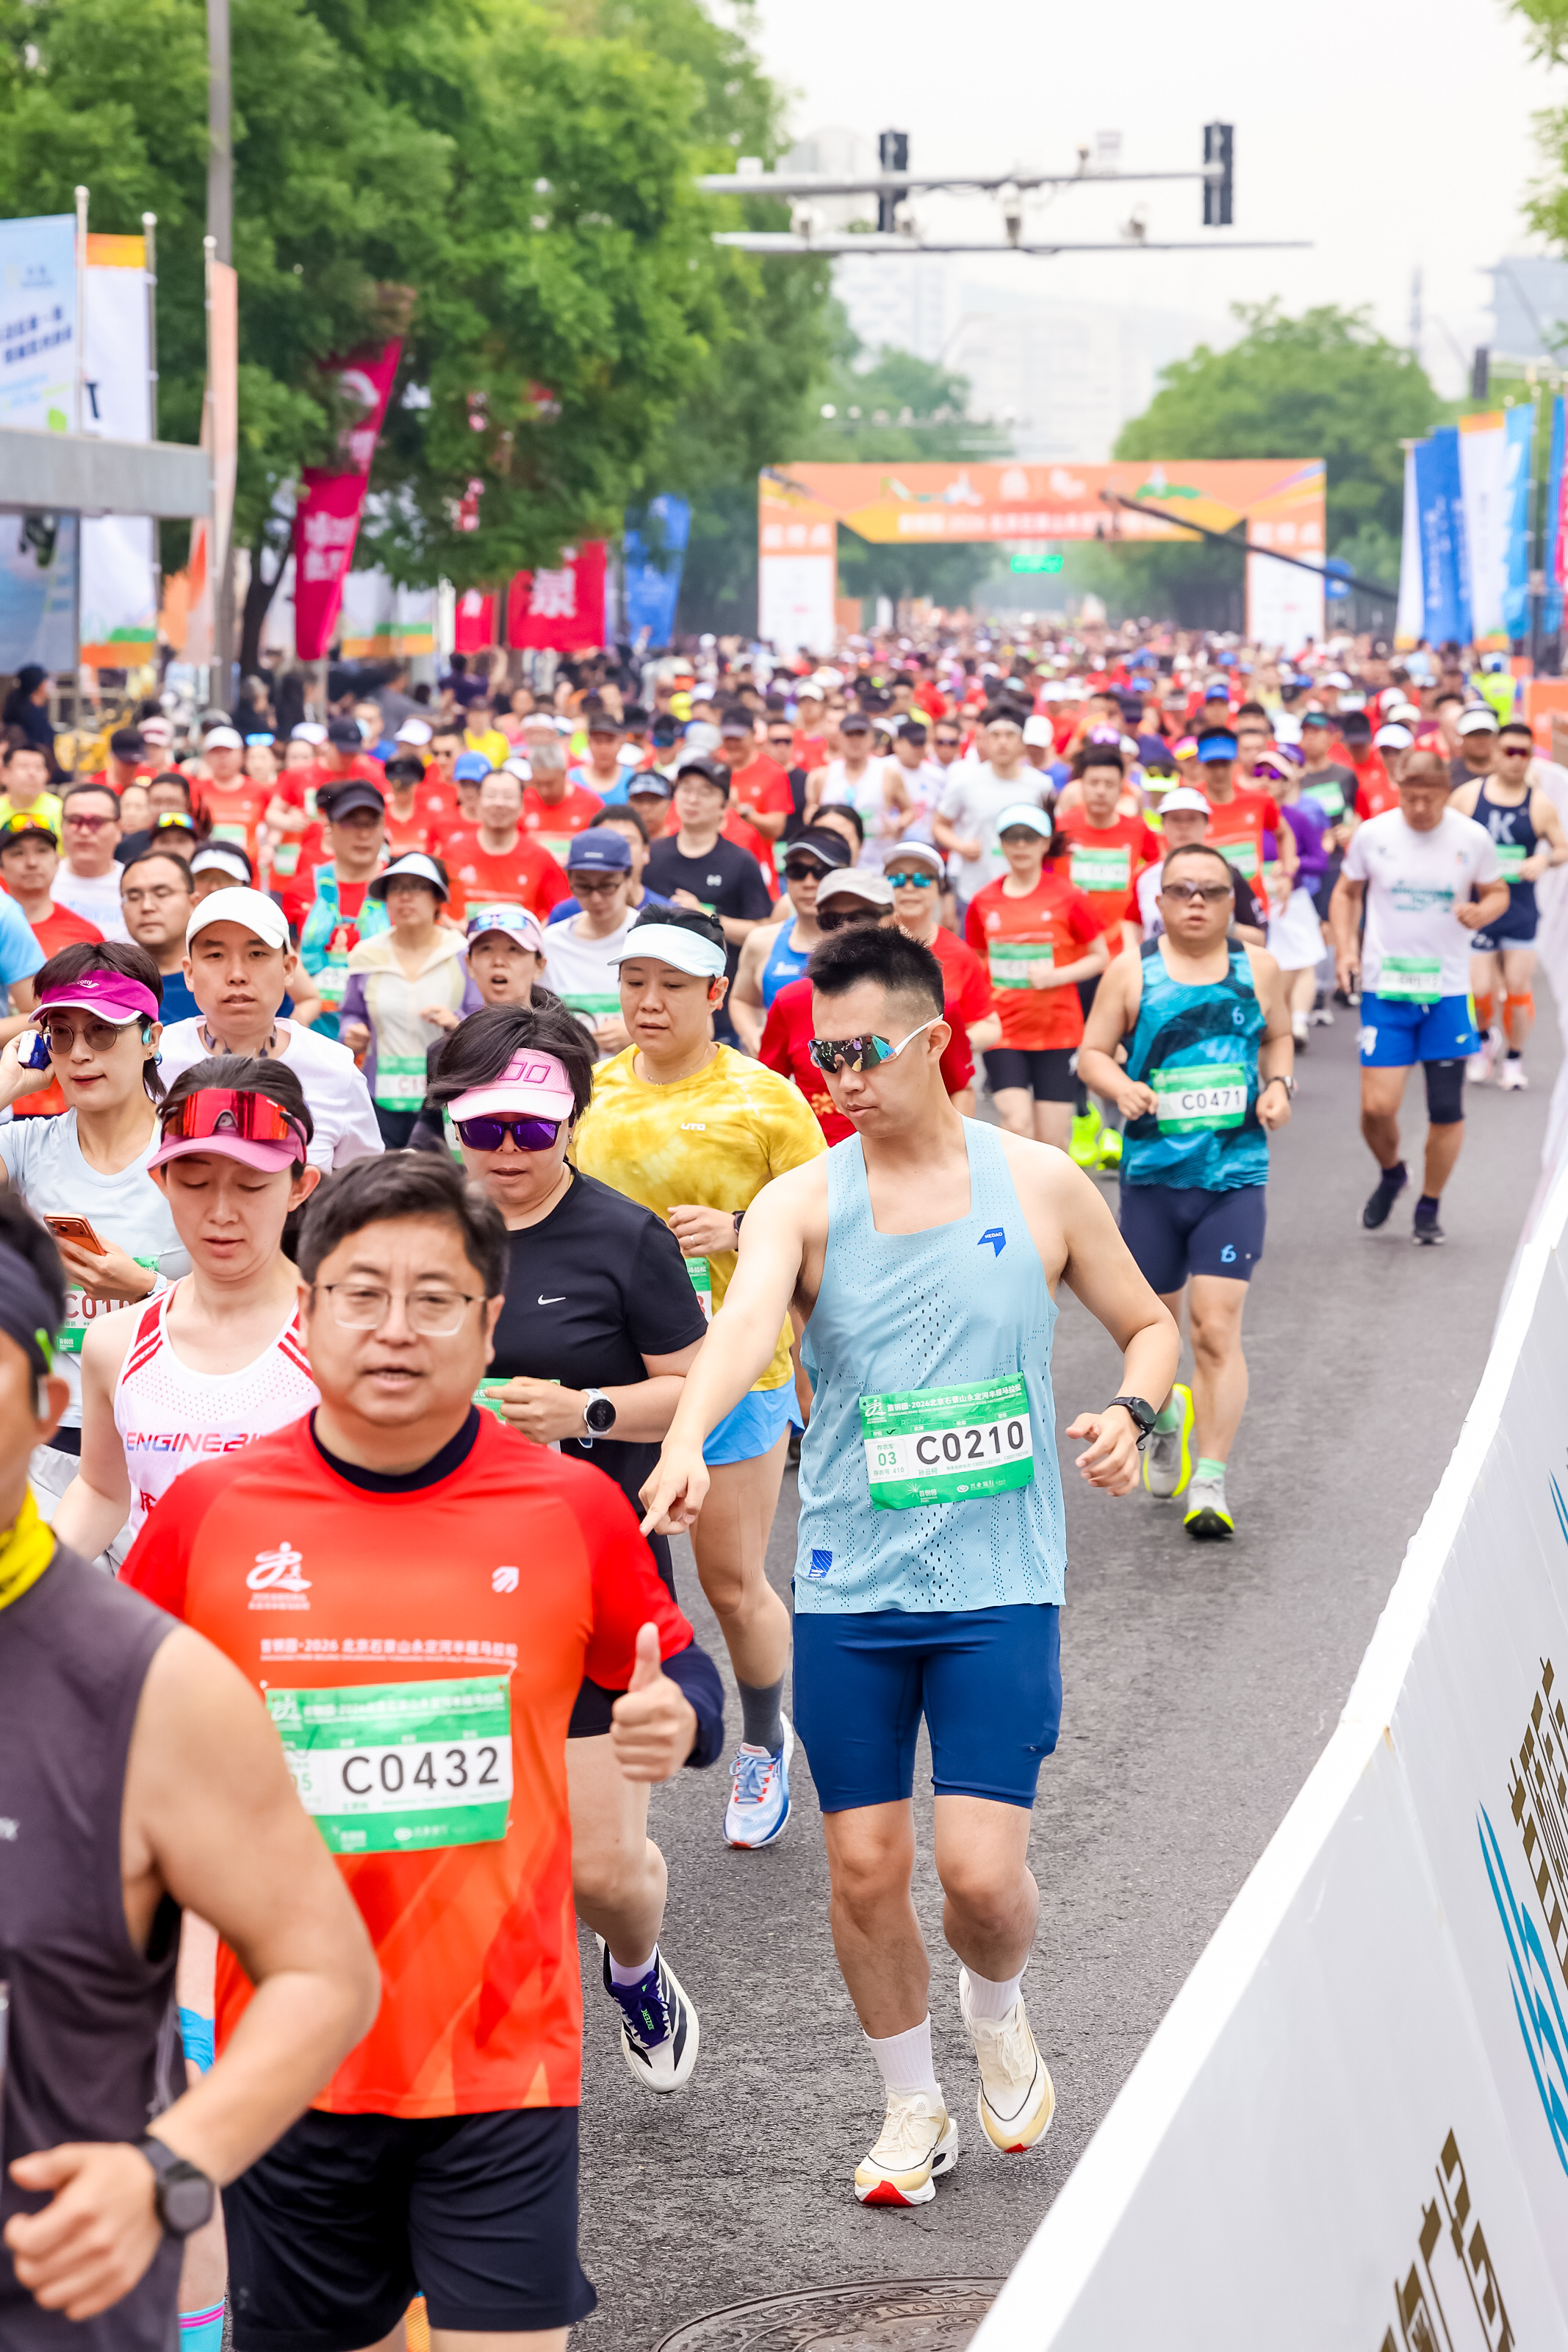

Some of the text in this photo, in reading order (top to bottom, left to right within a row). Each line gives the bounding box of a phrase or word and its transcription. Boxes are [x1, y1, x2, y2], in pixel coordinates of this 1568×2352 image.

[1487, 809, 1517, 845] K
[1182, 1090, 1242, 1111] C0471
[878, 1452, 897, 1466] 03
[916, 1421, 1024, 1465] C0210
[342, 1746, 500, 1794] C0432
